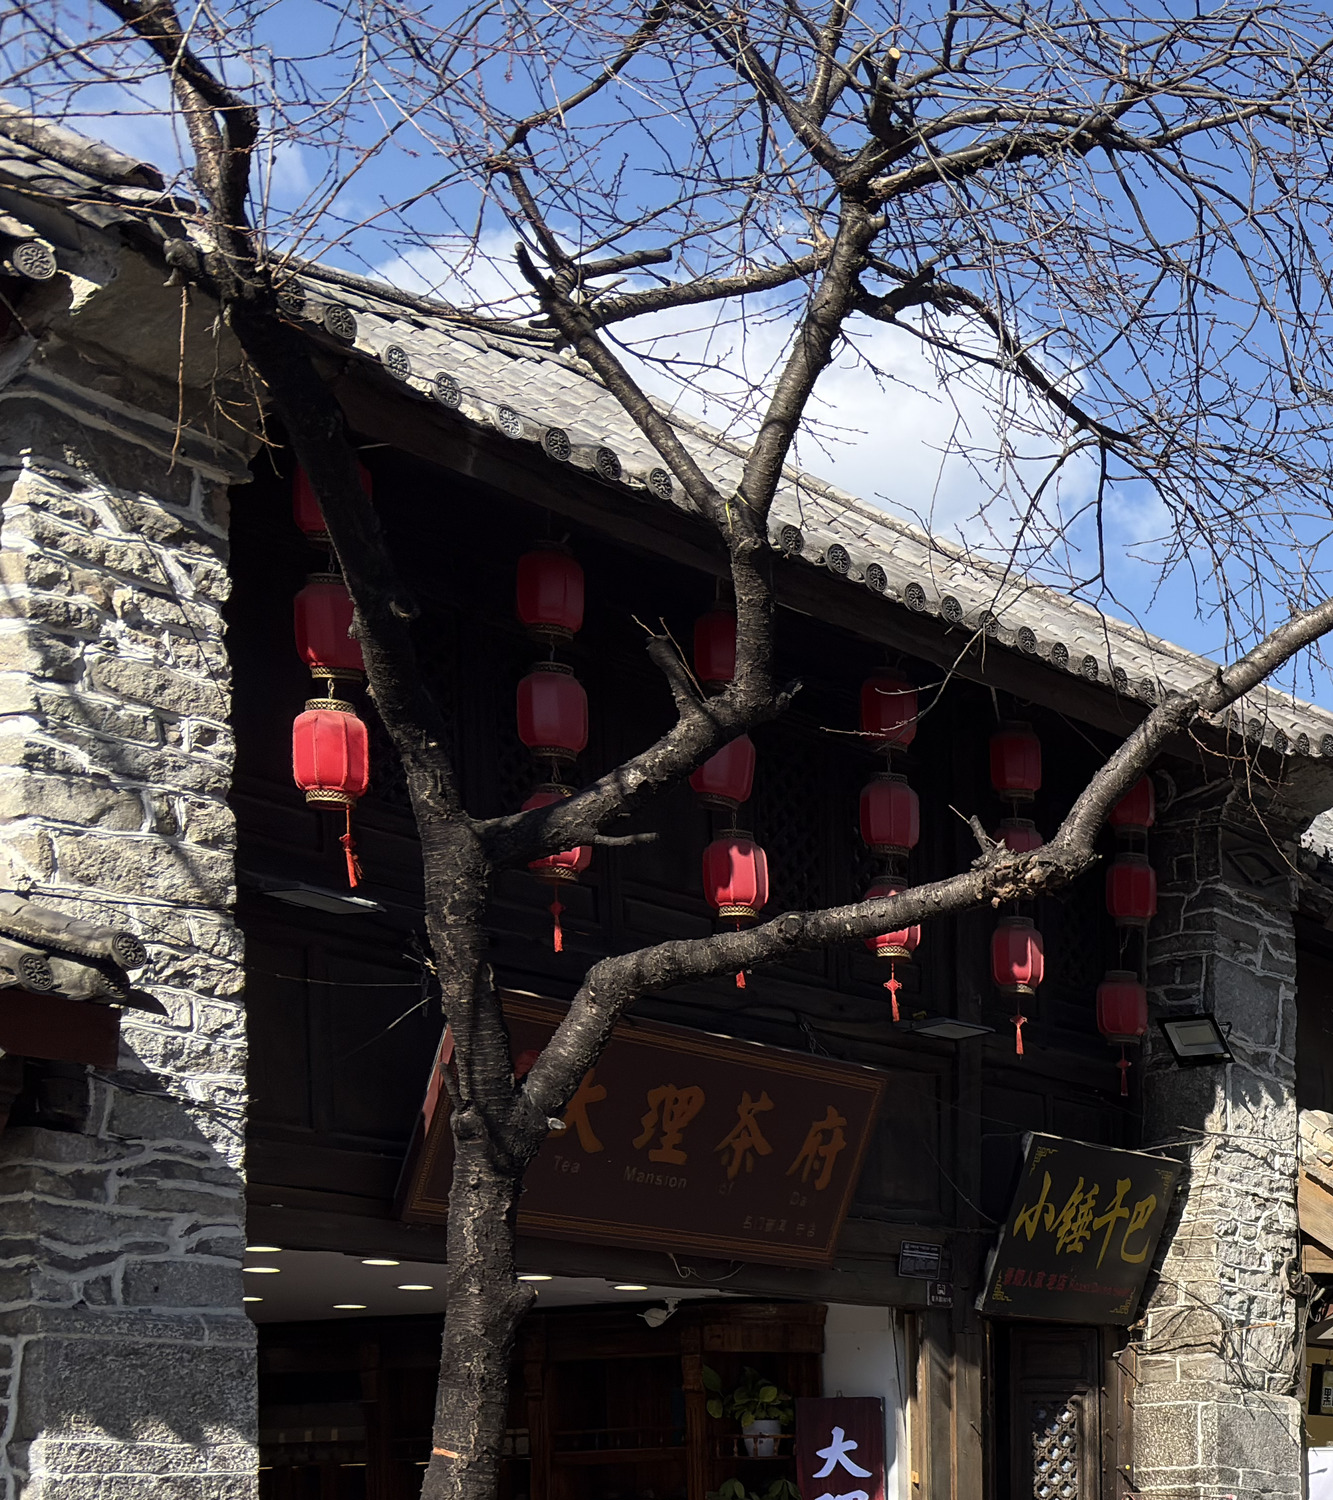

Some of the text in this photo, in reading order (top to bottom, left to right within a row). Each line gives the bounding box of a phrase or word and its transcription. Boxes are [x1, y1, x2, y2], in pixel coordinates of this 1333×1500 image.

[551, 1067, 848, 1189] 大理茶府
[623, 1165, 688, 1189] Mansion
[1013, 1170, 1157, 1270] 小锤干巴
